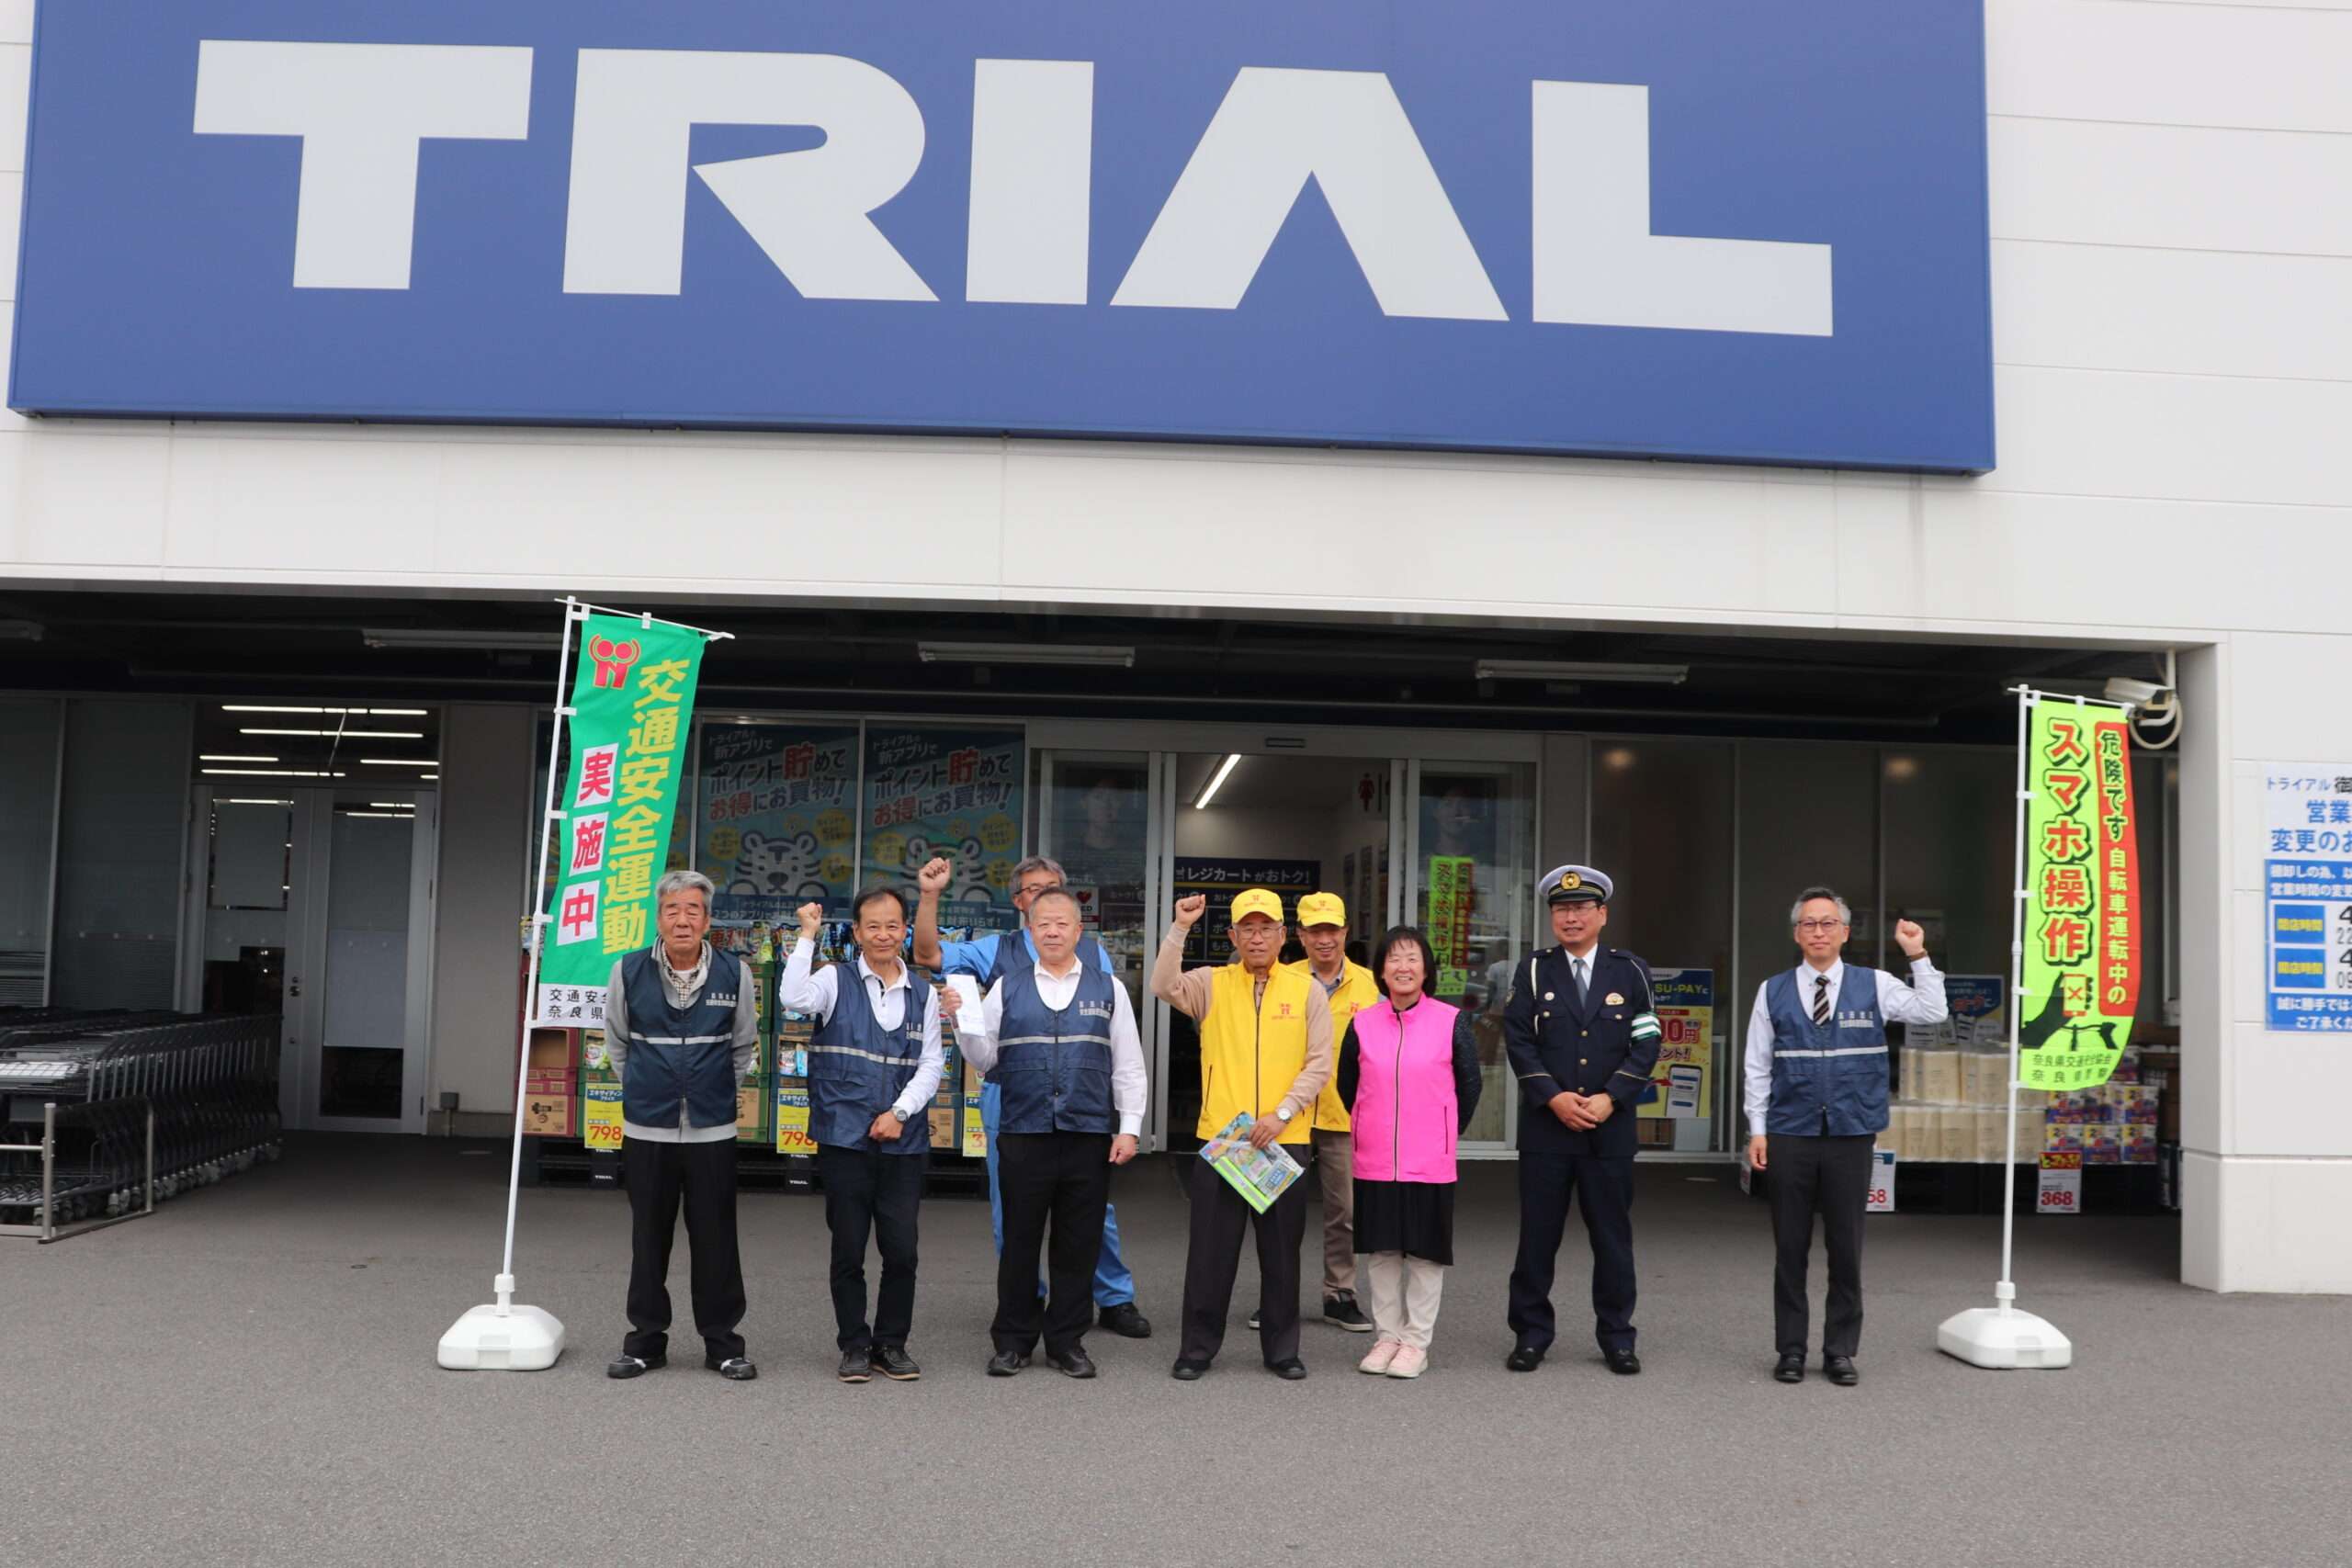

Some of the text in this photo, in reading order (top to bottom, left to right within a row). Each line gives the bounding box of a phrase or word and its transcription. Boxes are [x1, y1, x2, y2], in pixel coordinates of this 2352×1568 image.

[192, 39, 1834, 337] TRIAL
[709, 742, 847, 795] ポイント貯めて
[874, 747, 1012, 800] ポイント貯めて
[2267, 777, 2331, 791] トライアル
[601, 658, 691, 955] 交通安全運動
[561, 750, 615, 938] 実施中
[2041, 718, 2092, 964] スマホ操作
[589, 1125, 622, 1141] 798
[2041, 1190, 2074, 1206] 368
